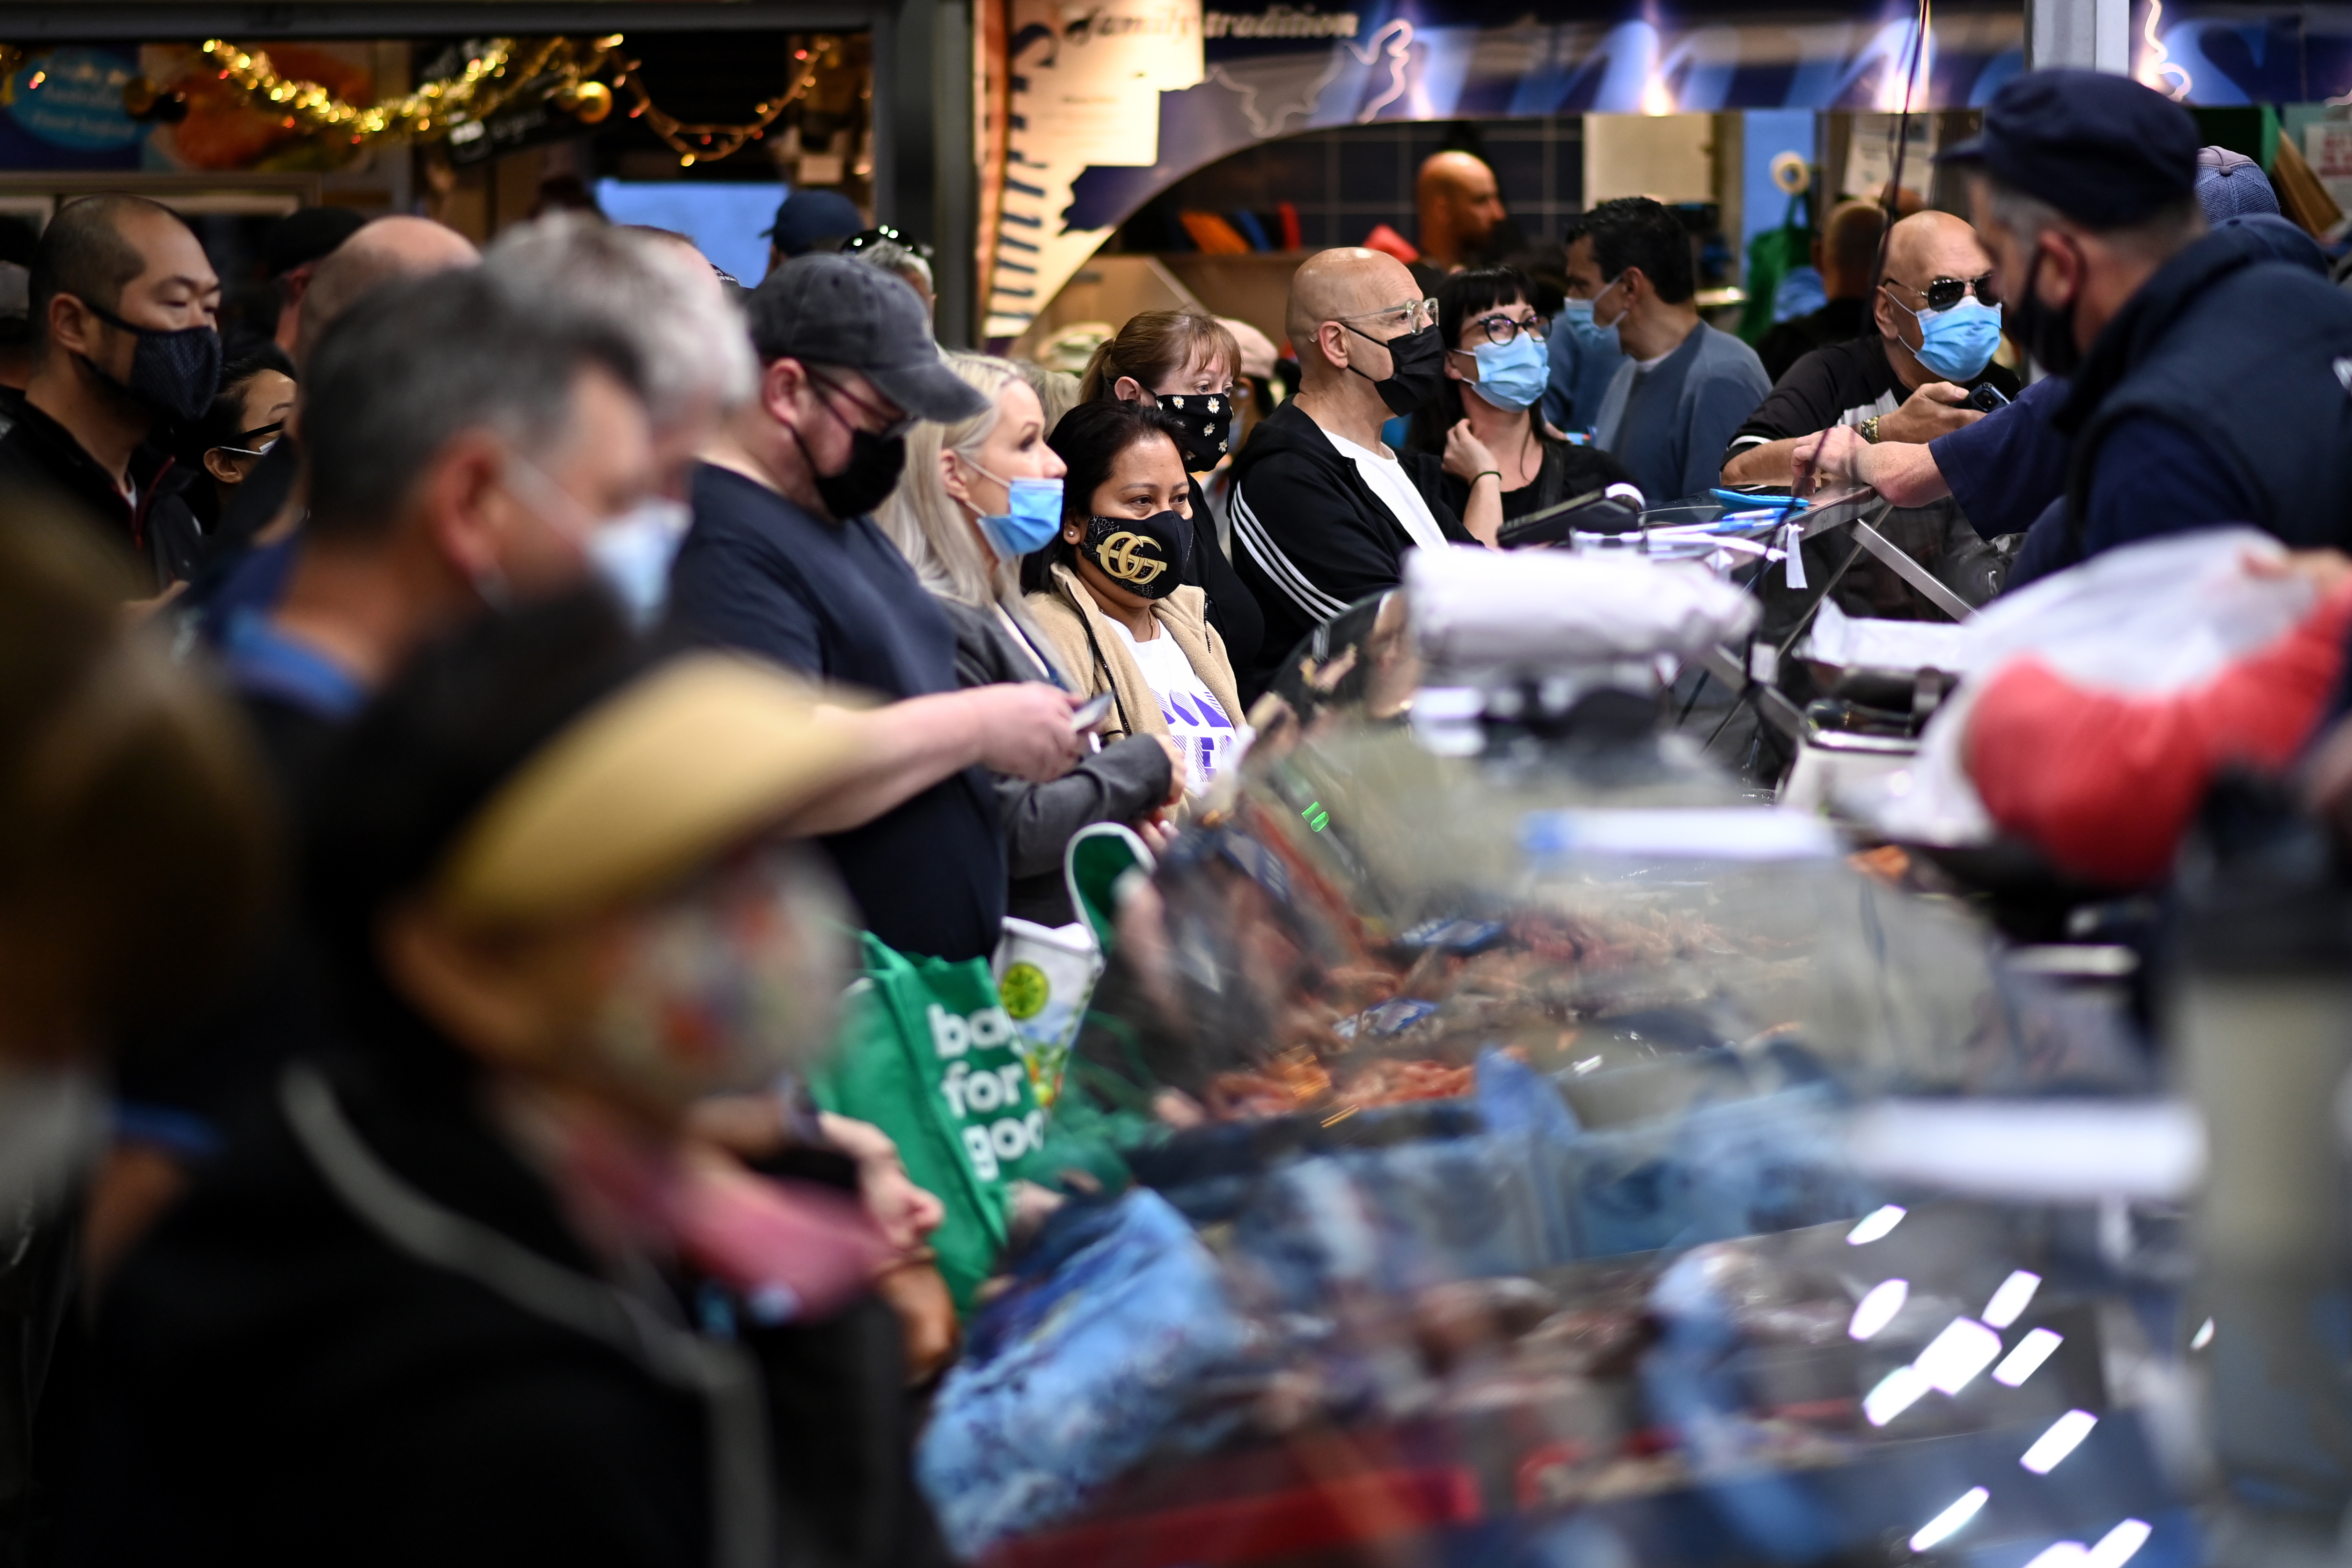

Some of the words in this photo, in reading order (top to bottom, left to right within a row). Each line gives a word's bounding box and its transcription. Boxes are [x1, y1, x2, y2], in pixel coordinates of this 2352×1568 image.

[1066, 5, 1199, 46] family
[1202, 4, 1358, 38] tradition
[941, 1060, 1024, 1119] for
